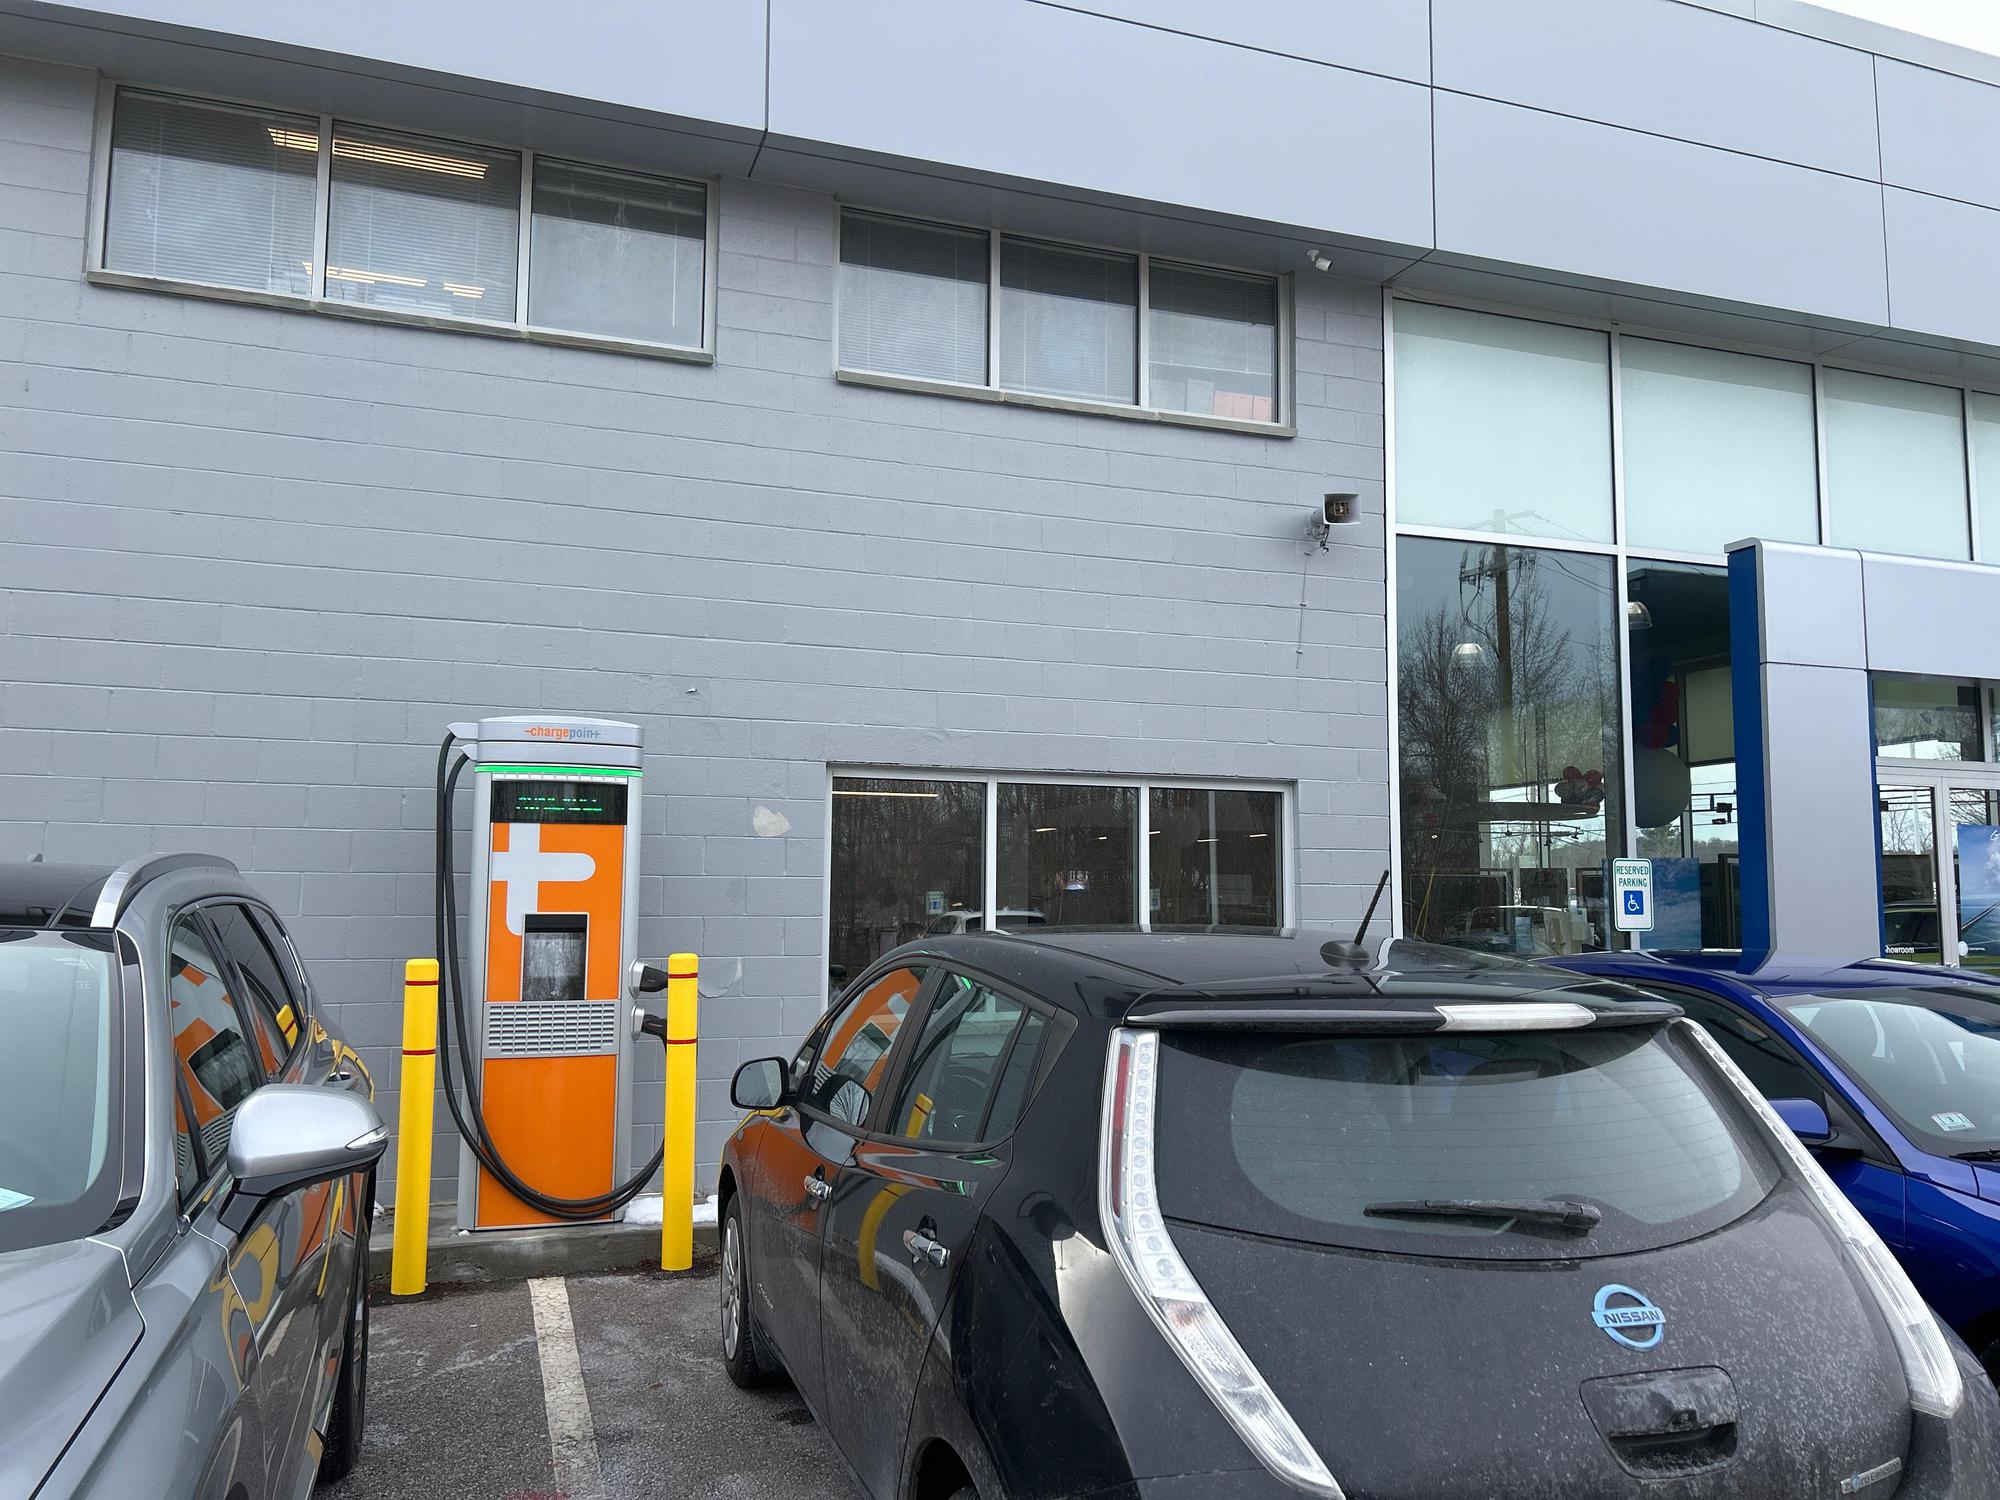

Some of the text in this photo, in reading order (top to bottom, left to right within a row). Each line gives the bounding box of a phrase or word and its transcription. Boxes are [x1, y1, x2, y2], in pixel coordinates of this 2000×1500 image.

[1616, 865, 1649, 876] RESERVED
[1618, 877, 1648, 888] PARKING
[1603, 1310, 1661, 1324] NISSAN
